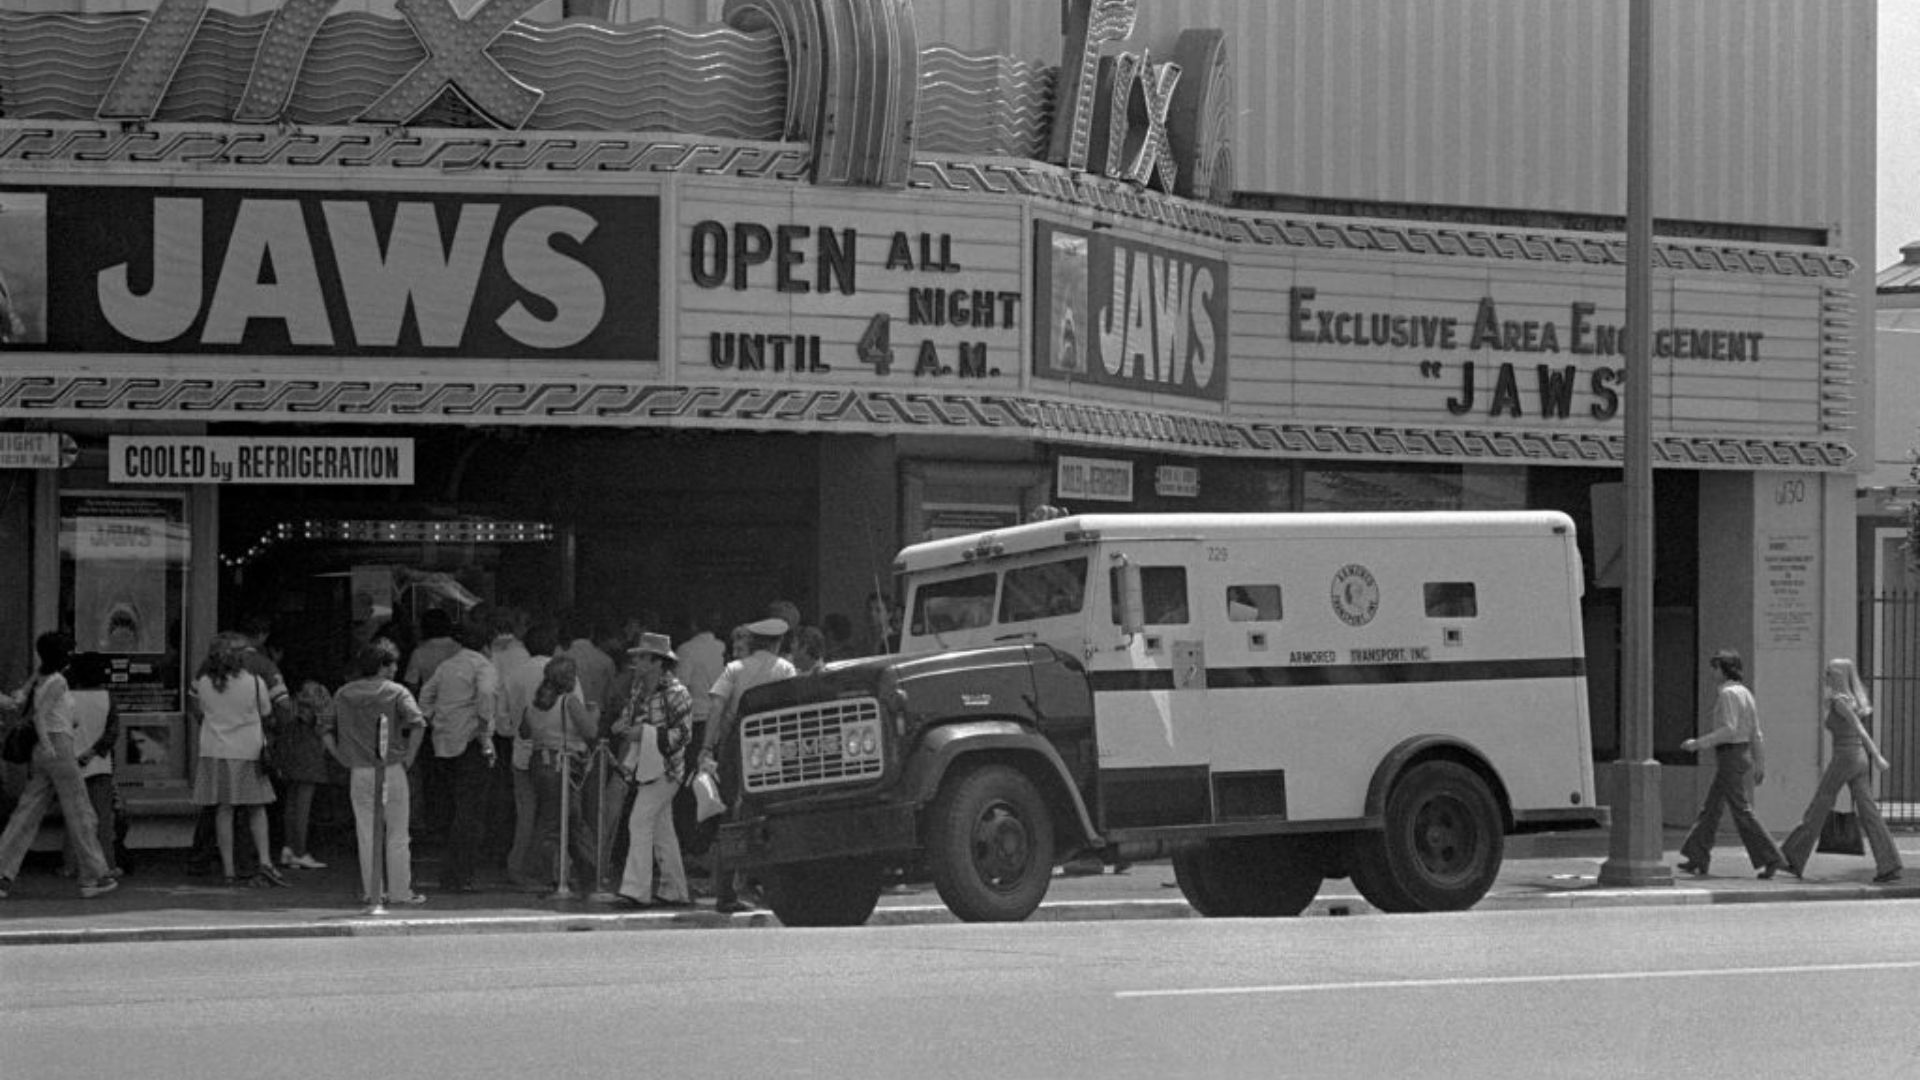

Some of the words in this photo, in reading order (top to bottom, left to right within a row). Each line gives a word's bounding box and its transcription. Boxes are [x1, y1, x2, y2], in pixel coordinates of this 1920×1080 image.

[97, 197, 606, 349] JAWS
[690, 219, 857, 295] OPEN
[886, 231, 961, 273] ALL
[908, 287, 1022, 329] NIGHT
[1098, 246, 1216, 389] JAWS
[1469, 296, 1560, 354] AREA
[1571, 302, 1764, 362] ENGEMENT
[710, 332, 831, 373] UNTIL
[857, 313, 894, 376] 4
[914, 340, 1001, 378] A.M.
[125, 445, 206, 478] COOLED
[210, 451, 233, 482] by
[238, 445, 399, 479] REFRIGERATION
[1289, 651, 1336, 664] ARMORED
